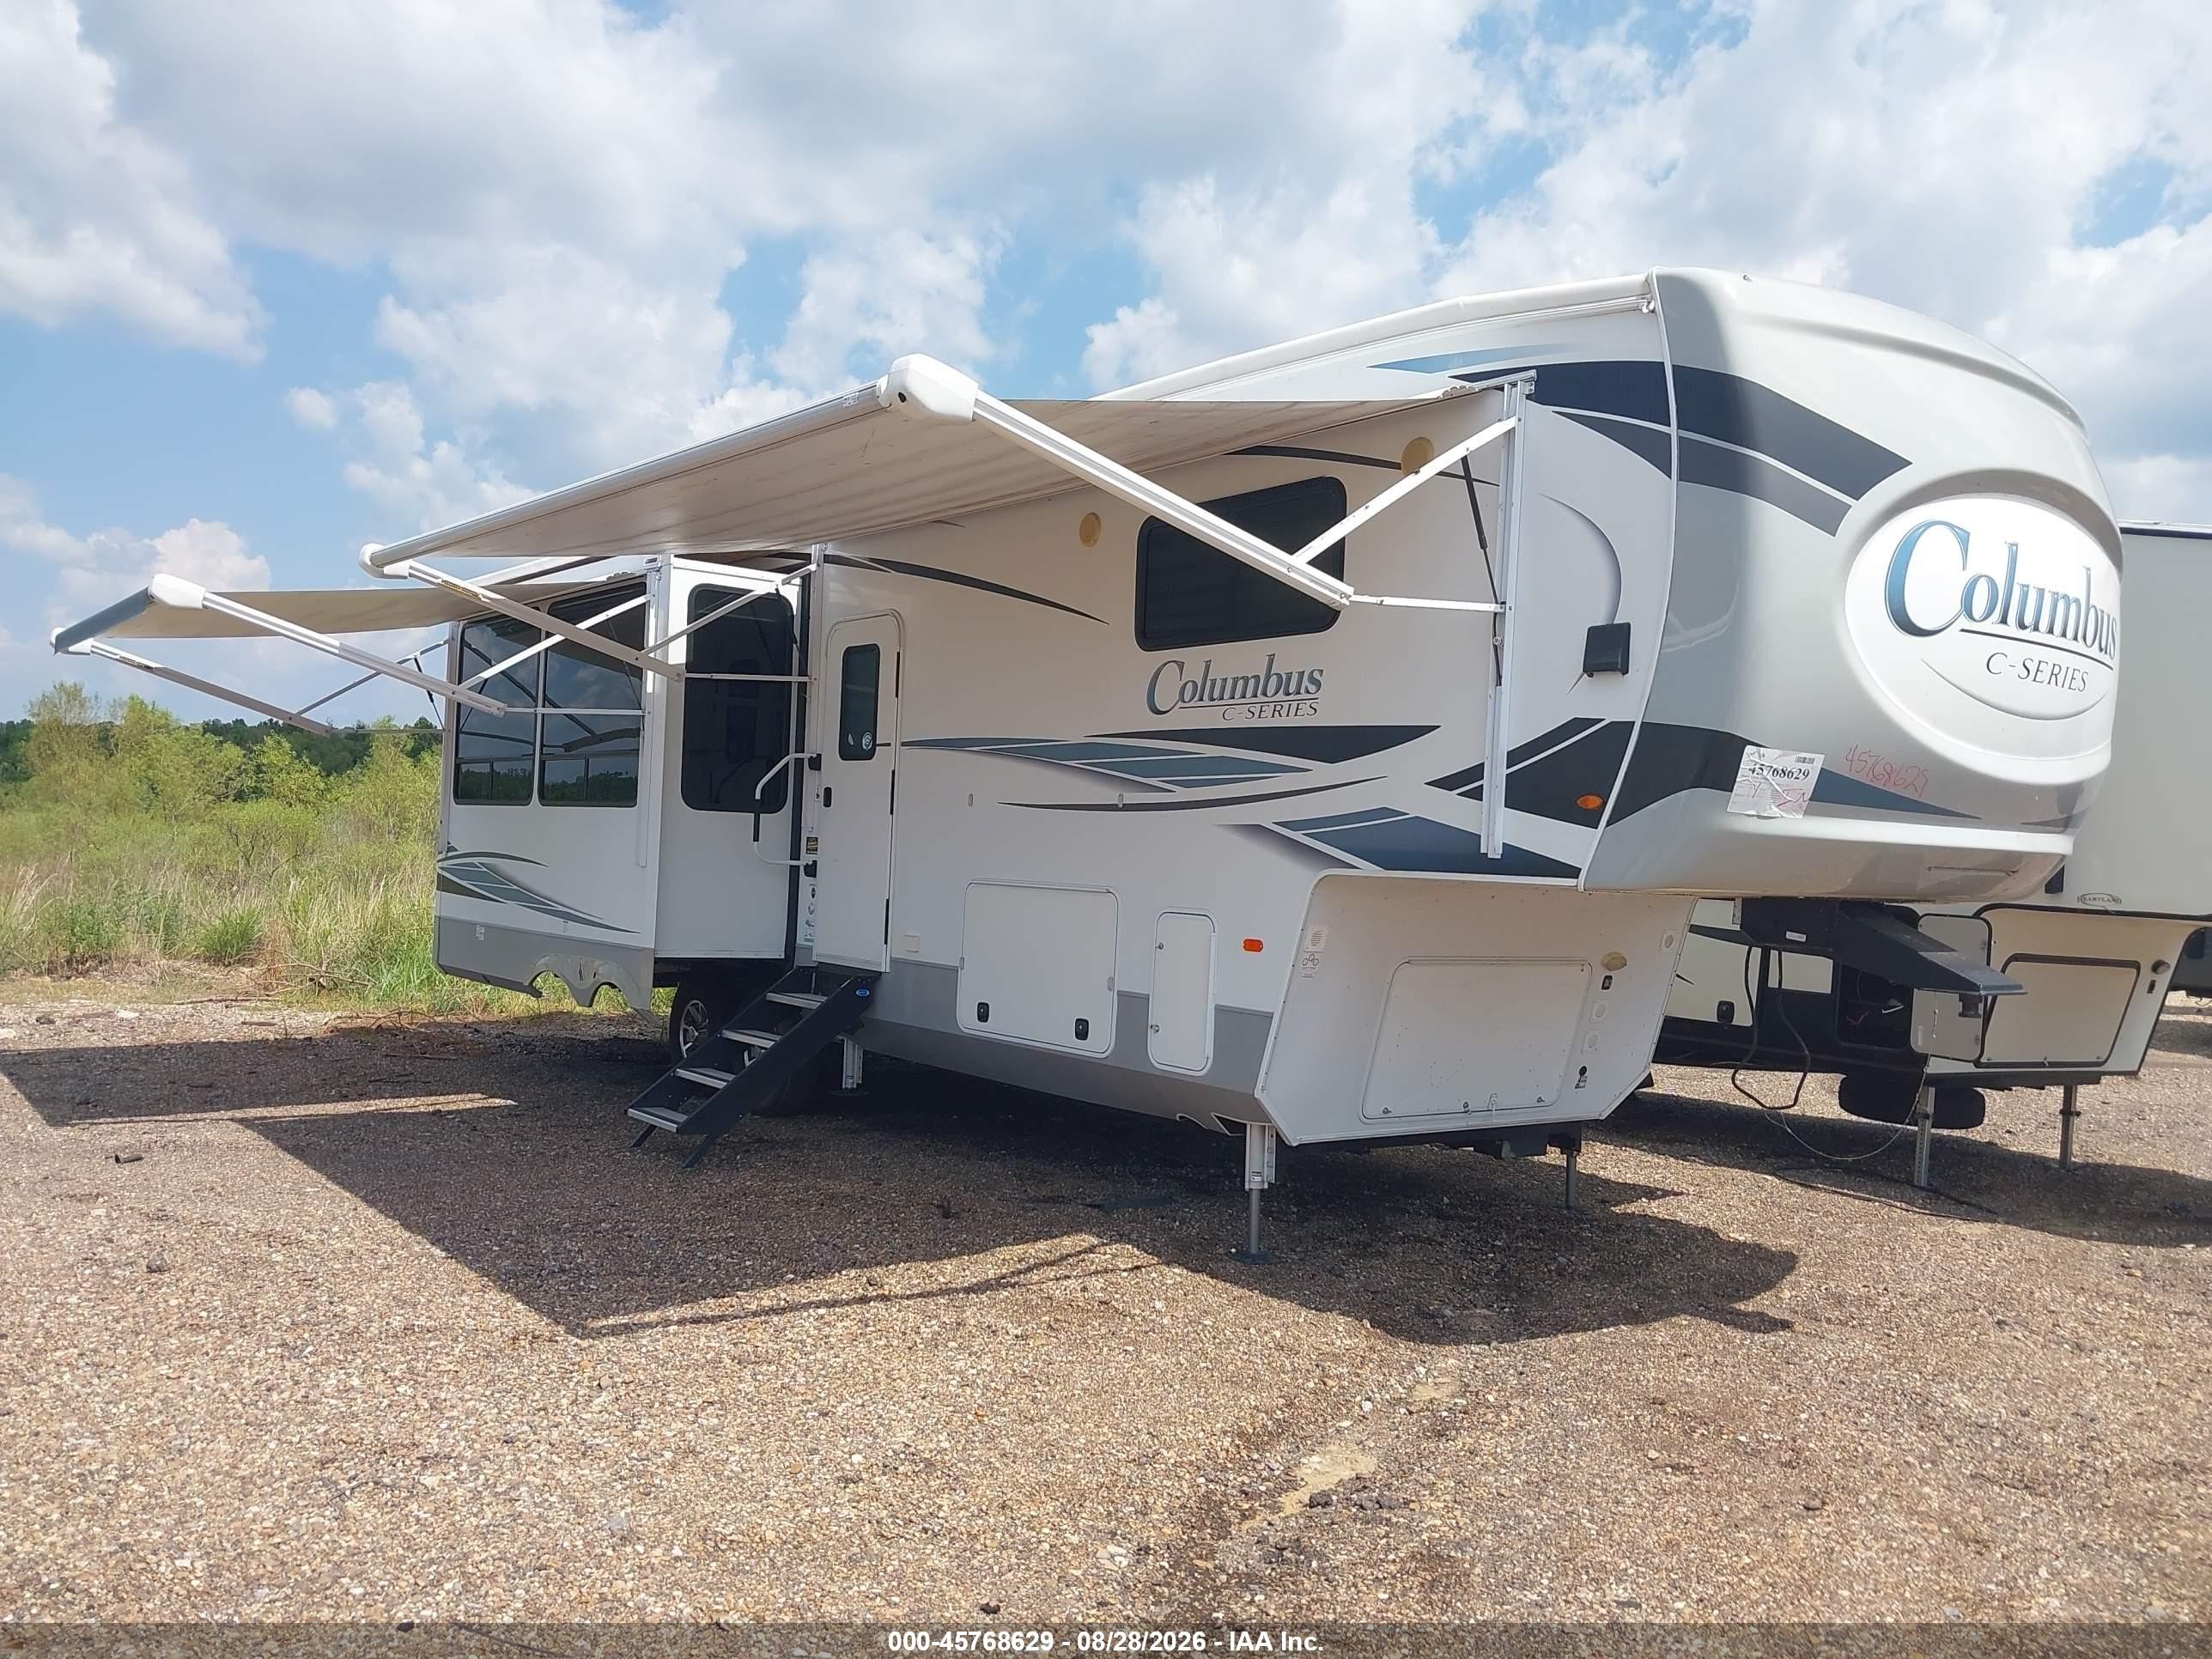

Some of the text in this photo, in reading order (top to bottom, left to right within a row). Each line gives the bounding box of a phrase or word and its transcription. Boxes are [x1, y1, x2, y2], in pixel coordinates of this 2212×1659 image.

[1885, 520, 2117, 660] Columbus
[1146, 653, 1324, 715] Columbus
[1986, 652, 2089, 693] C-SERIES
[1222, 702, 1319, 721] C-SERIES
[1748, 762, 1810, 781] 45768629
